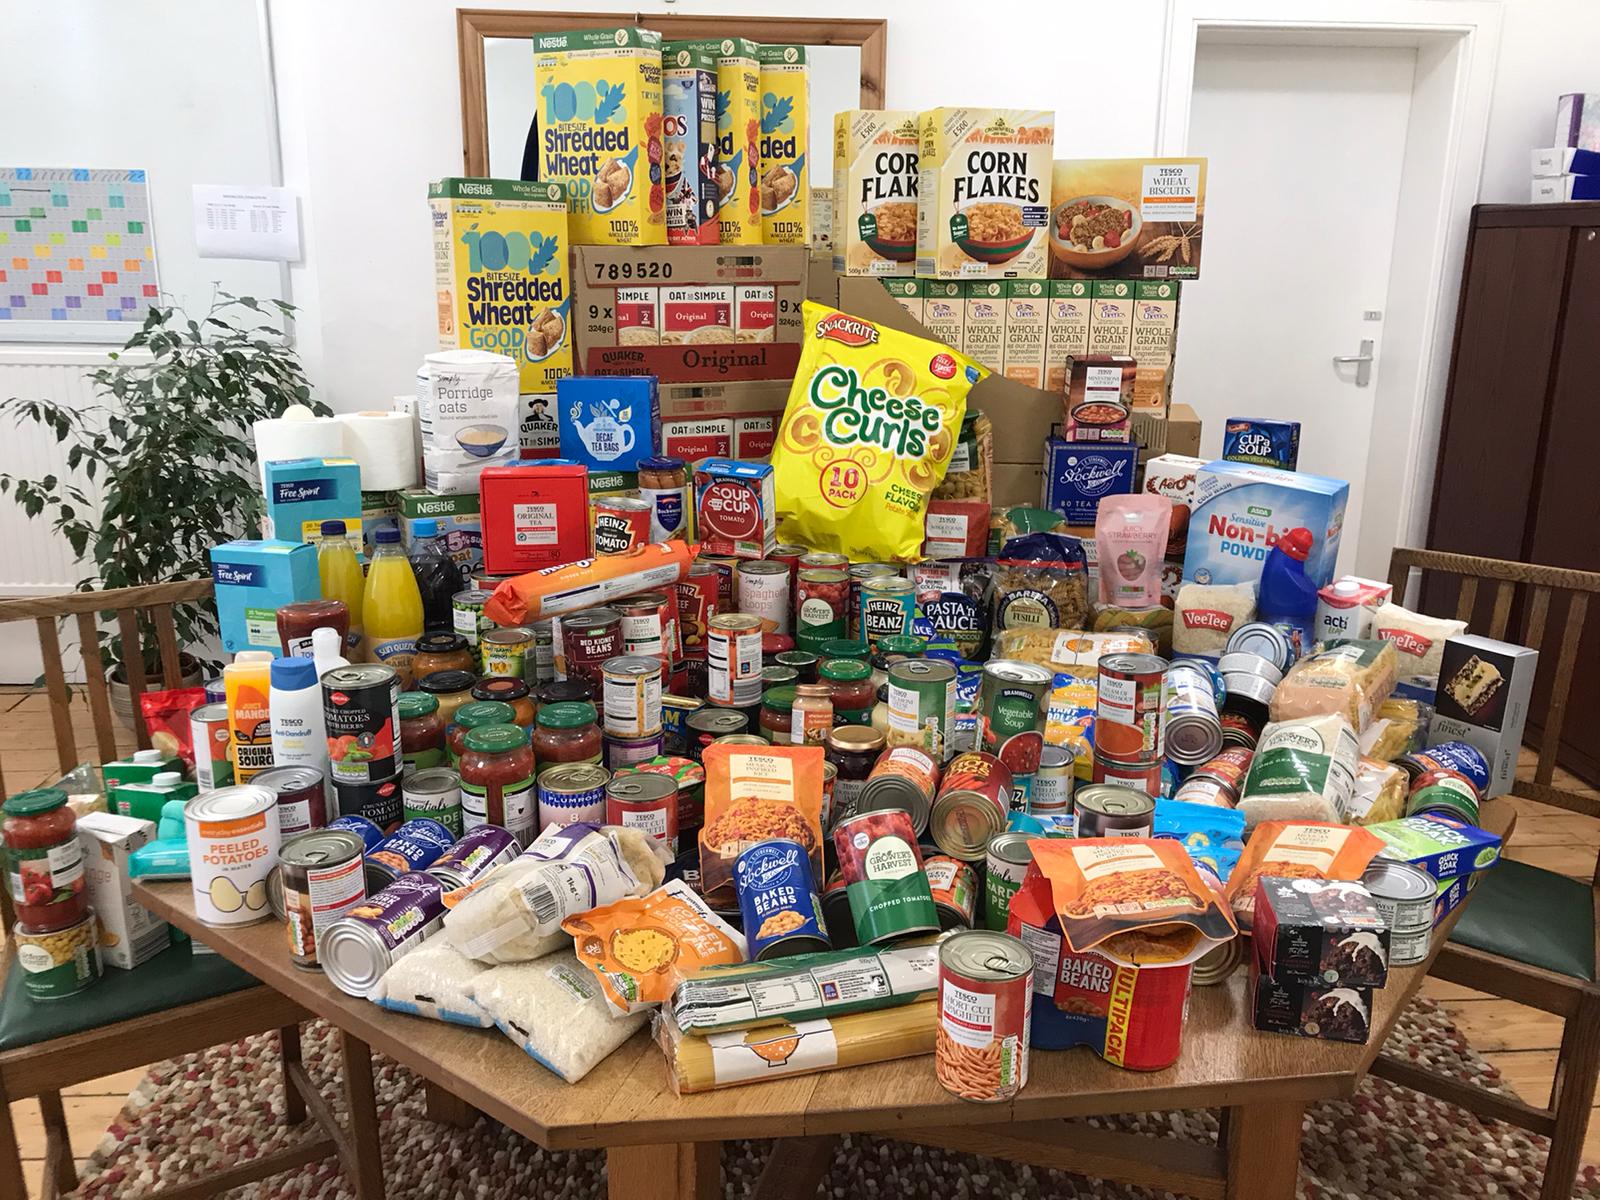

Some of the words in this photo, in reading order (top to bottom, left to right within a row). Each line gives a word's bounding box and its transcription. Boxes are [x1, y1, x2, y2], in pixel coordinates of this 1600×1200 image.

[701, 98, 716, 110] WIN
[558, 123, 586, 132] BITESIZE
[545, 127, 629, 152] Shredded
[546, 153, 599, 176] Wheat
[875, 152, 918, 175] COR
[967, 151, 1027, 175] CORN
[1160, 168, 1183, 176] TESCO
[1153, 177, 1188, 186] WHEAT
[458, 183, 494, 195] Nestlé
[862, 176, 918, 203] FLAK
[954, 175, 1039, 203] FLAKES
[1149, 187, 1191, 195] BISCUITS
[666, 208, 683, 217] WIN
[609, 220, 638, 232] 100%
[773, 222, 803, 233] 100%
[486, 272, 521, 282] BITESIZE
[594, 262, 673, 280] 789520
[467, 277, 563, 301] Shredded
[744, 290, 761, 299] OAT
[669, 291, 687, 301] OAT
[694, 291, 726, 300] SIMPLE
[589, 305, 599, 319] 9
[604, 307, 613, 318] x
[780, 300, 789, 313] 9
[468, 302, 534, 326] Wheat
[675, 312, 707, 323] Original
[816, 318, 880, 343] SNACKRITE
[967, 326, 1002, 334] WHOLE
[1008, 325, 1043, 334] WHOLE
[1050, 326, 1085, 334] WHOLE
[1092, 326, 1128, 335] WHOLE
[1135, 328, 1171, 336] WHOLE
[469, 328, 524, 349] GOOD
[968, 335, 999, 343] GRAIN
[1009, 335, 1040, 343] GRAIN
[1051, 335, 1082, 343] GRAIN
[1094, 335, 1125, 344] GRAIN
[1136, 336, 1168, 345] GRAIN
[602, 351, 646, 363] QUAKER
[683, 348, 767, 374] Original
[544, 368, 572, 380] 100%
[438, 387, 493, 401] Porridge
[811, 366, 940, 432] Cheese
[439, 402, 467, 414] oats
[520, 423, 559, 433] QUAKER
[671, 425, 689, 435] OAT
[695, 424, 726, 434] SIMPLE
[743, 421, 760, 430] OAT
[825, 407, 927, 457] Curls
[596, 432, 613, 442] DECAF
[592, 442, 603, 453] TEA
[605, 442, 620, 452] BAGS
[677, 445, 708, 455] Original
[1238, 444, 1272, 457] SOUP
[828, 466, 860, 489] 10
[1060, 459, 1128, 485] Stockwell
[590, 475, 624, 489] Nestlé
[280, 488, 297, 498] Free
[298, 486, 321, 498] Spirit
[712, 487, 751, 502] SOUP
[828, 488, 858, 500] PACK
[417, 502, 457, 514] Nestlé
[723, 500, 751, 514] CUP
[1250, 507, 1269, 515] ASDA
[597, 515, 626, 529] HEINZ
[719, 515, 745, 523] TOMATO
[1230, 513, 1267, 527] Sensitive
[596, 534, 627, 550] TOMATO
[1221, 541, 1266, 561] POWD
[218, 569, 232, 581] Free
[233, 571, 252, 583] Spirit
[676, 599, 689, 609] EEF
[744, 601, 773, 610] Loops
[870, 602, 902, 613] HEINZ
[927, 602, 963, 616] PASTA
[867, 615, 904, 629] BEANZ
[1012, 612, 1041, 623] FUSILLI
[1185, 612, 1229, 630] VeeTee
[1324, 615, 1348, 630] acti
[594, 635, 615, 645] KIDNEY
[585, 643, 612, 655] BEANS
[997, 706, 1034, 721] Vegetable
[1004, 717, 1025, 730] Soup
[1434, 721, 1469, 738] finest
[238, 747, 272, 756] ORIGINA
[238, 756, 274, 767] SOURC
[210, 838, 260, 855] PEELED
[203, 846, 269, 866] POTATOES
[1439, 852, 1459, 865] QUICK
[739, 849, 800, 896] Stockwell
[872, 859, 912, 873] HARVEST
[1439, 860, 1458, 872] SOAK
[754, 886, 795, 904] BAKED
[986, 880, 1015, 899] GARD
[756, 895, 797, 916] BEANS
[869, 898, 901, 912] CHOPPED
[671, 905, 728, 953] GOLDEN
[1062, 957, 1113, 981] BAKED
[1060, 970, 1111, 993] BEANS
[954, 990, 978, 1003] TESCO
[972, 1002, 993, 1015] CUT
